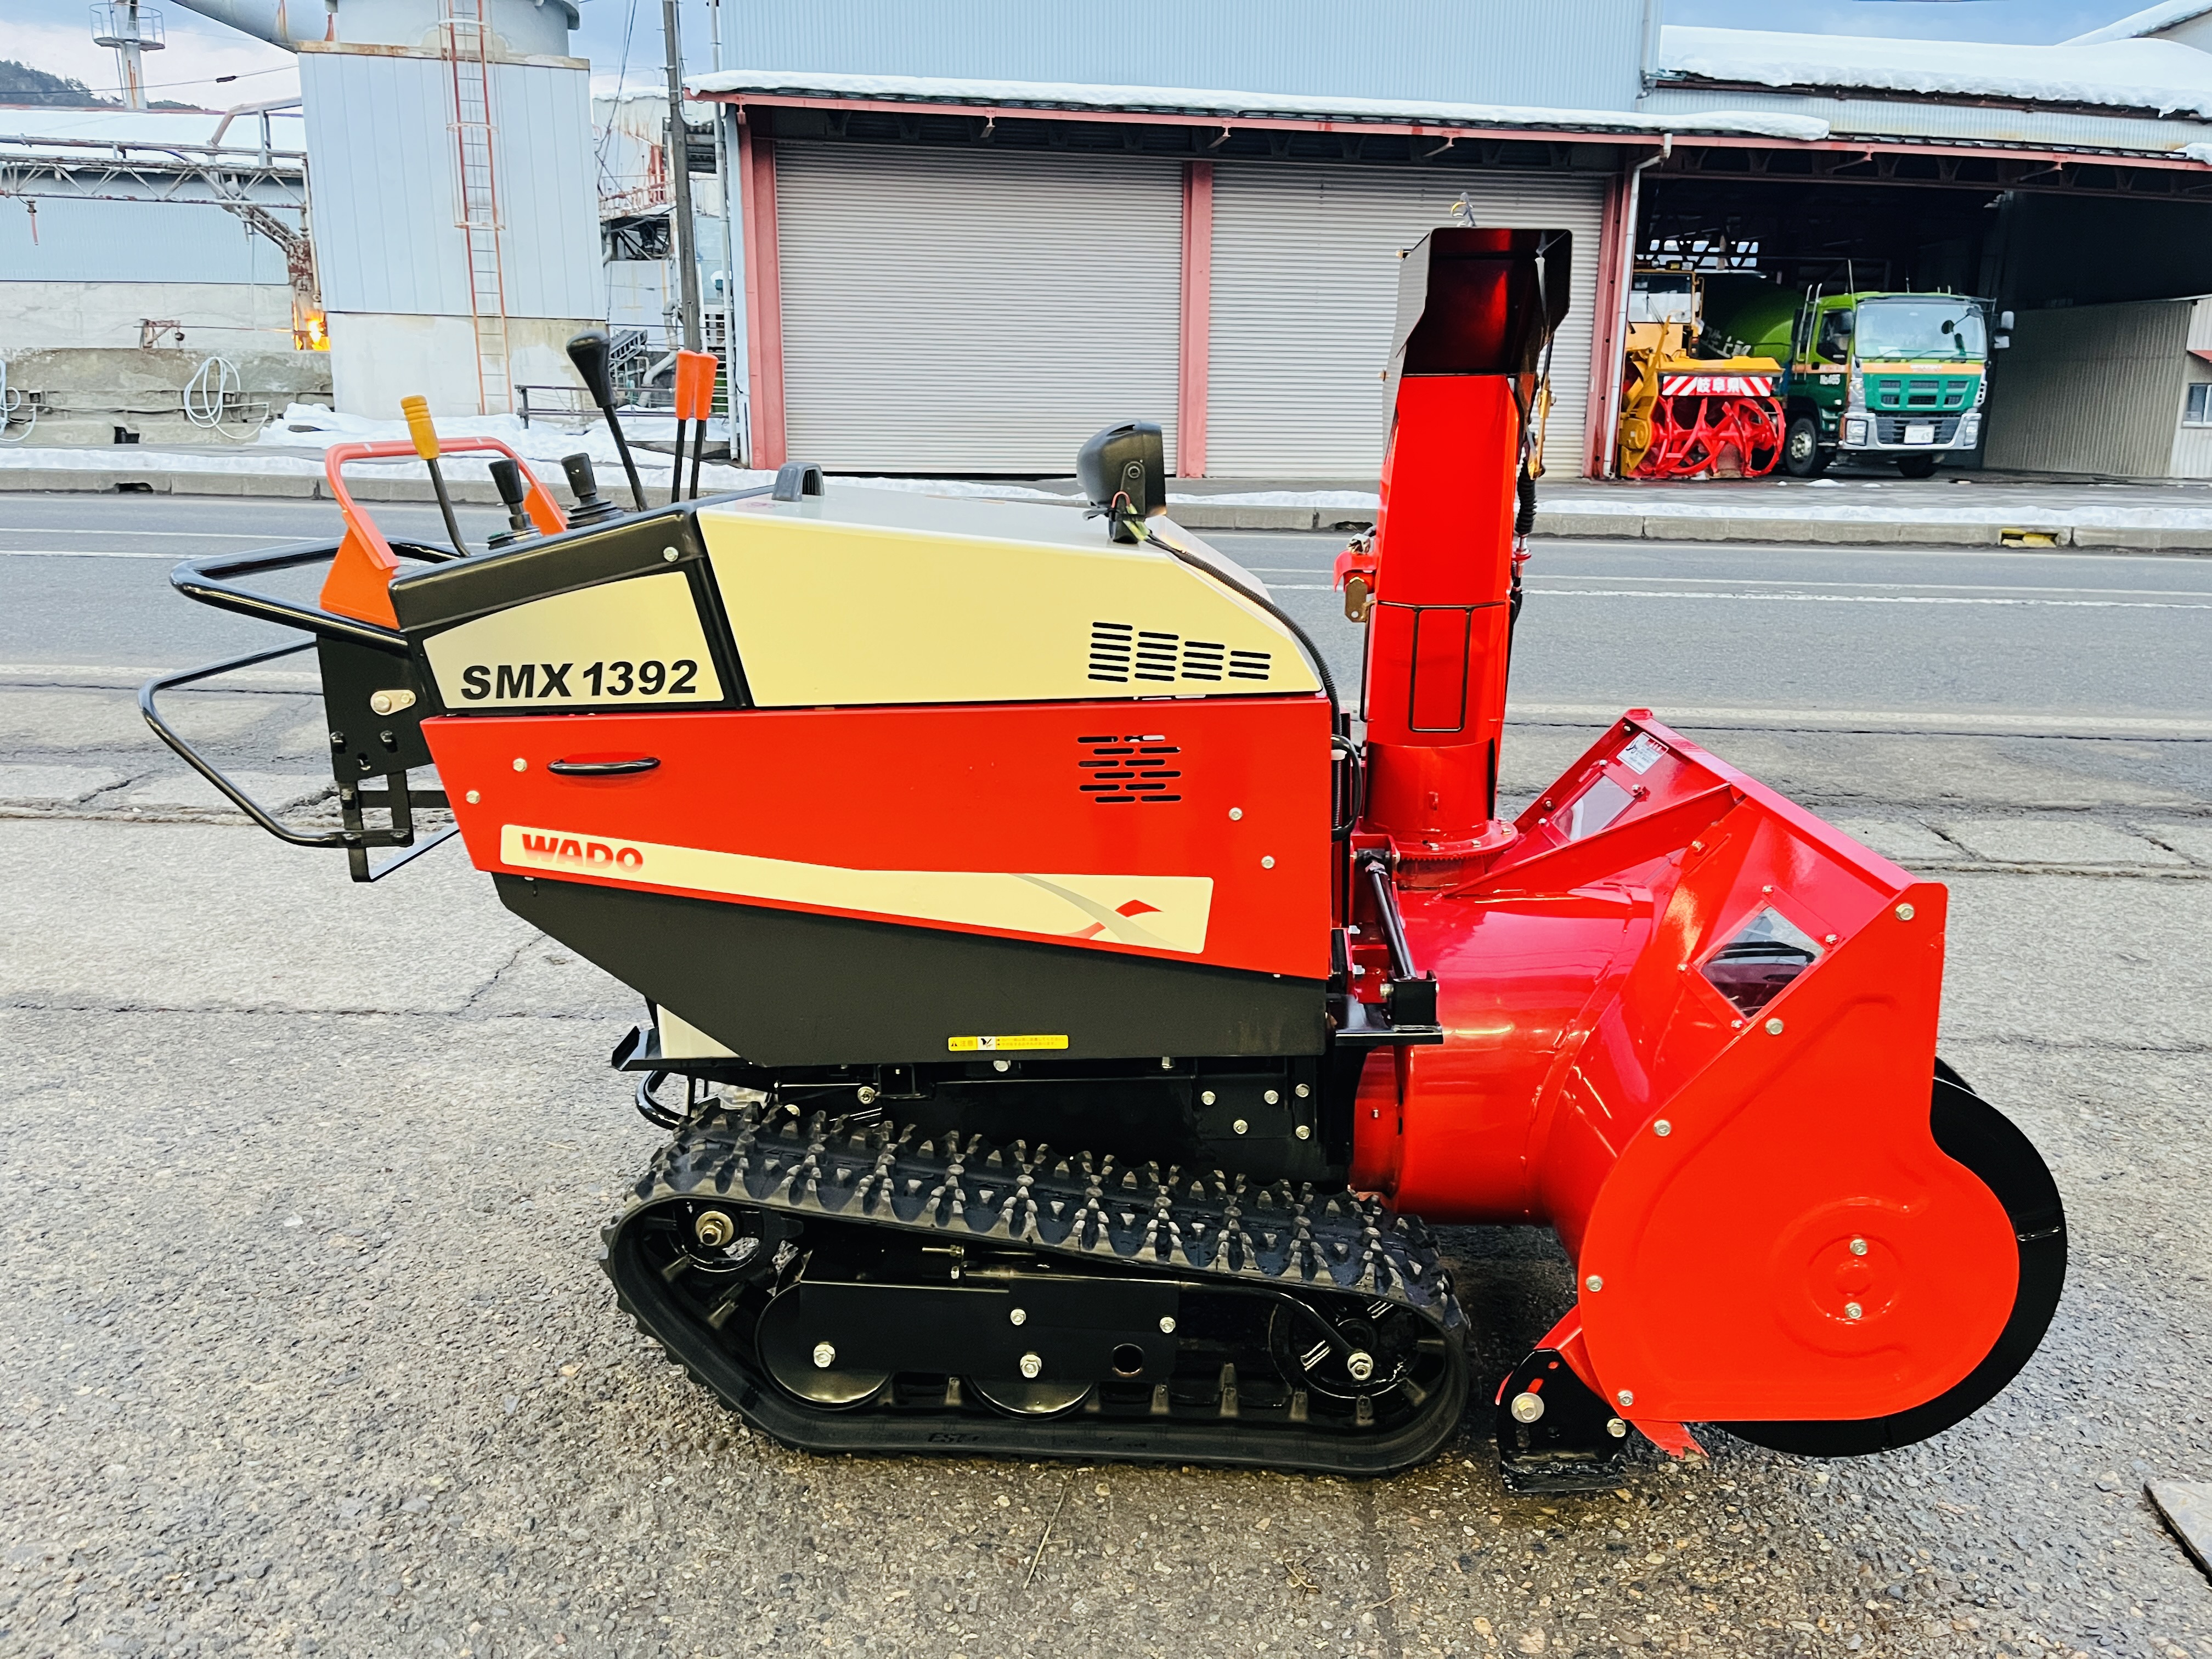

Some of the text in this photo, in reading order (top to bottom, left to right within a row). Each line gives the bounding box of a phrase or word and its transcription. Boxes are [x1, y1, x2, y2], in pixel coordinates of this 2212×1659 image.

[1697, 377, 1740, 393] 岐阜県
[461, 660, 697, 699] SMX 1392
[522, 834, 643, 872] WADO
